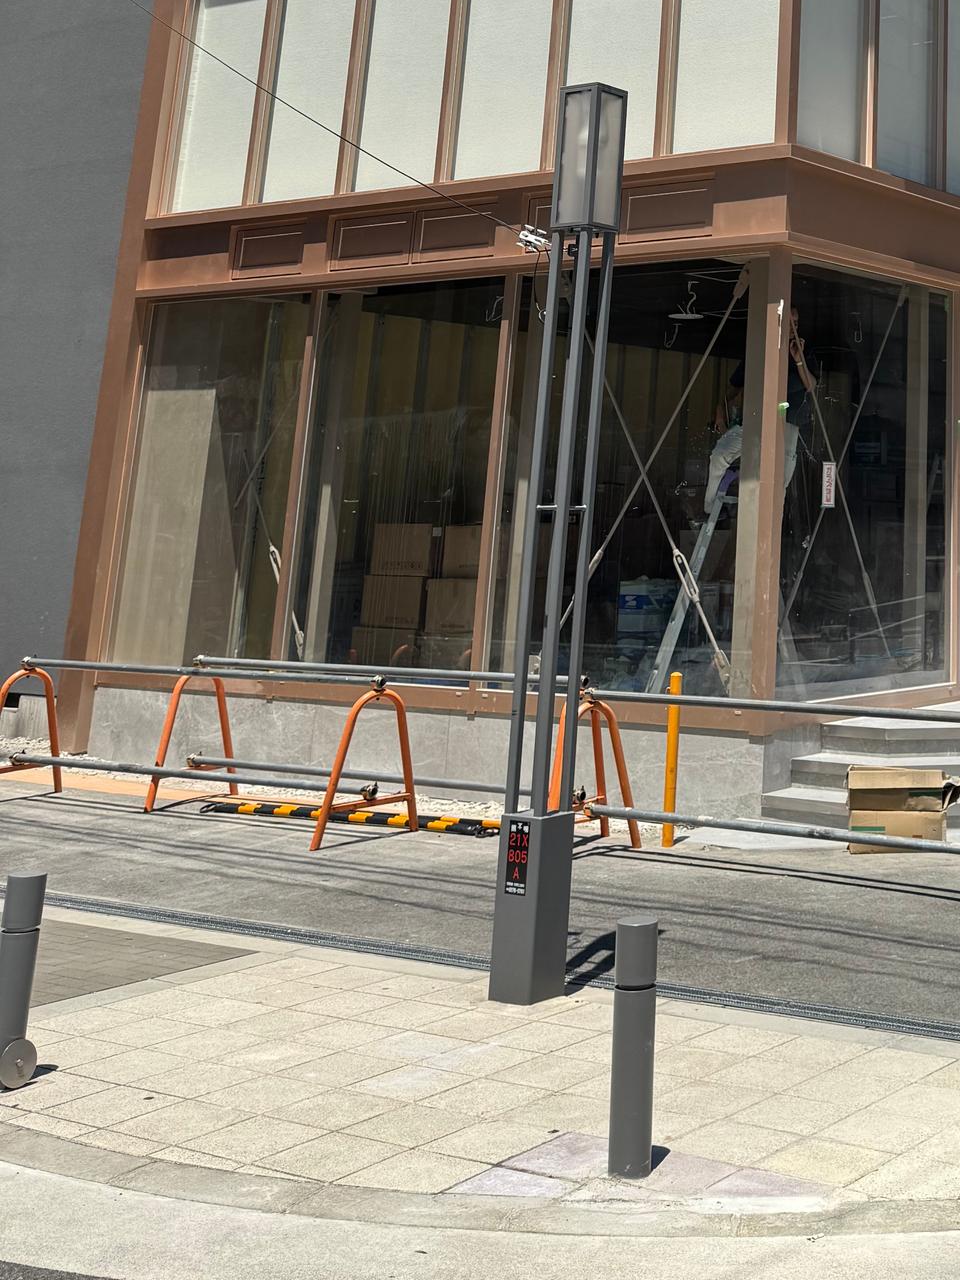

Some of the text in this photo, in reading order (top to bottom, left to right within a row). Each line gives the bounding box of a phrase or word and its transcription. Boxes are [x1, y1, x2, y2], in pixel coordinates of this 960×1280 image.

[509, 832, 529, 847] 21X
[508, 849, 528, 863] 805
[513, 866, 520, 880] A
